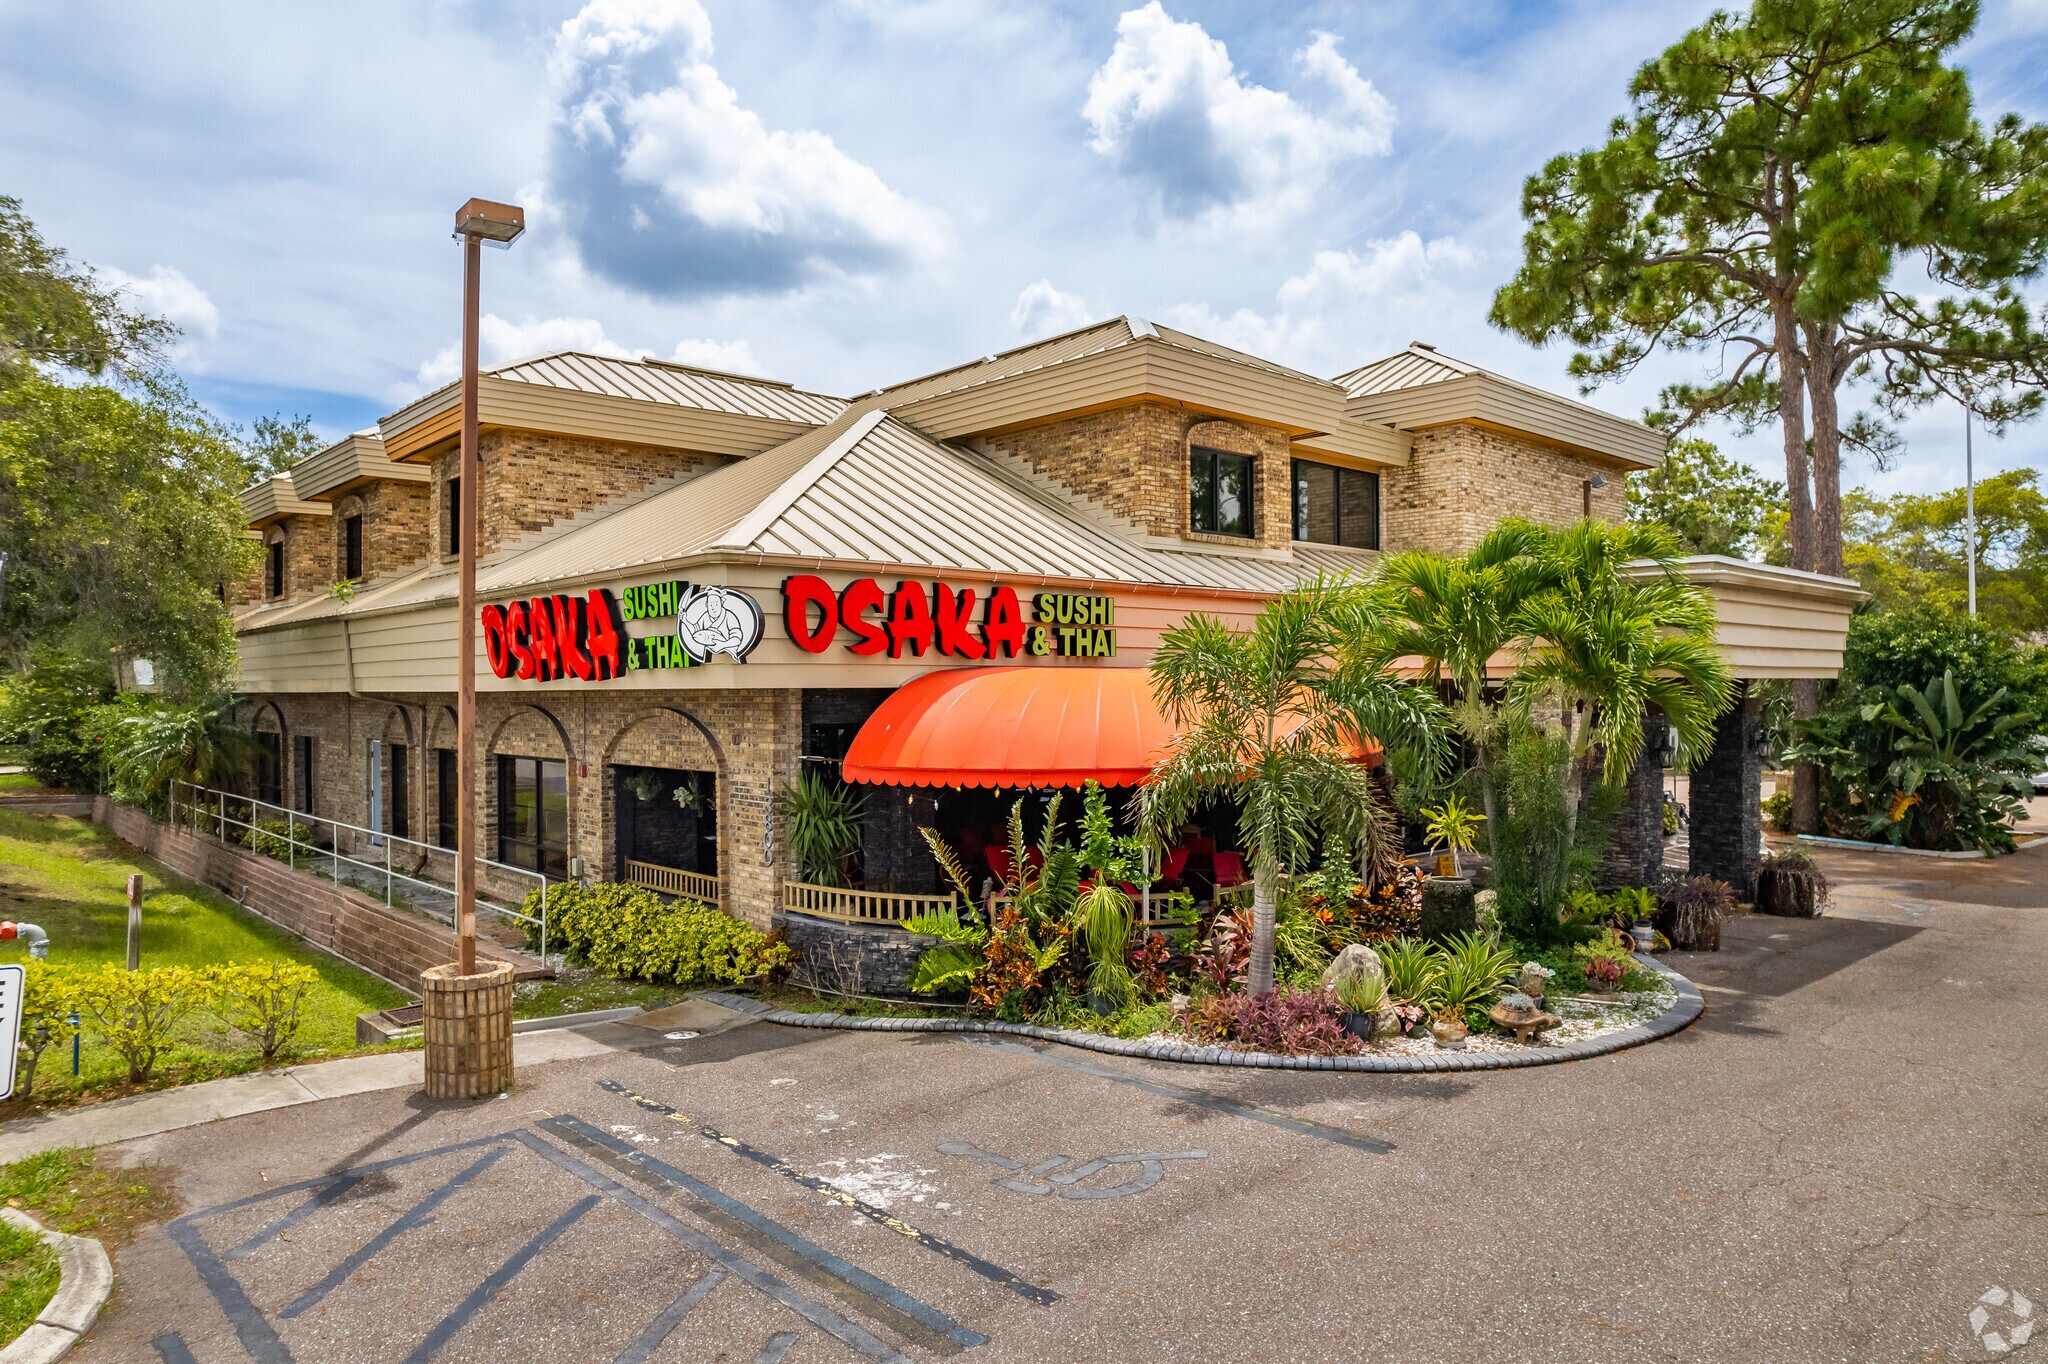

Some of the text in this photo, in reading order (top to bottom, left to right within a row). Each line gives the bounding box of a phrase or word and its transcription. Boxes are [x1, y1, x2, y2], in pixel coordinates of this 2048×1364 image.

[623, 580, 678, 620] SUSHI
[784, 575, 1026, 660] OSAKA
[1039, 593, 1114, 625] SUSHI
[481, 588, 619, 683] OSAKA
[628, 637, 640, 670] &
[1033, 626, 1116, 657] & THAI
